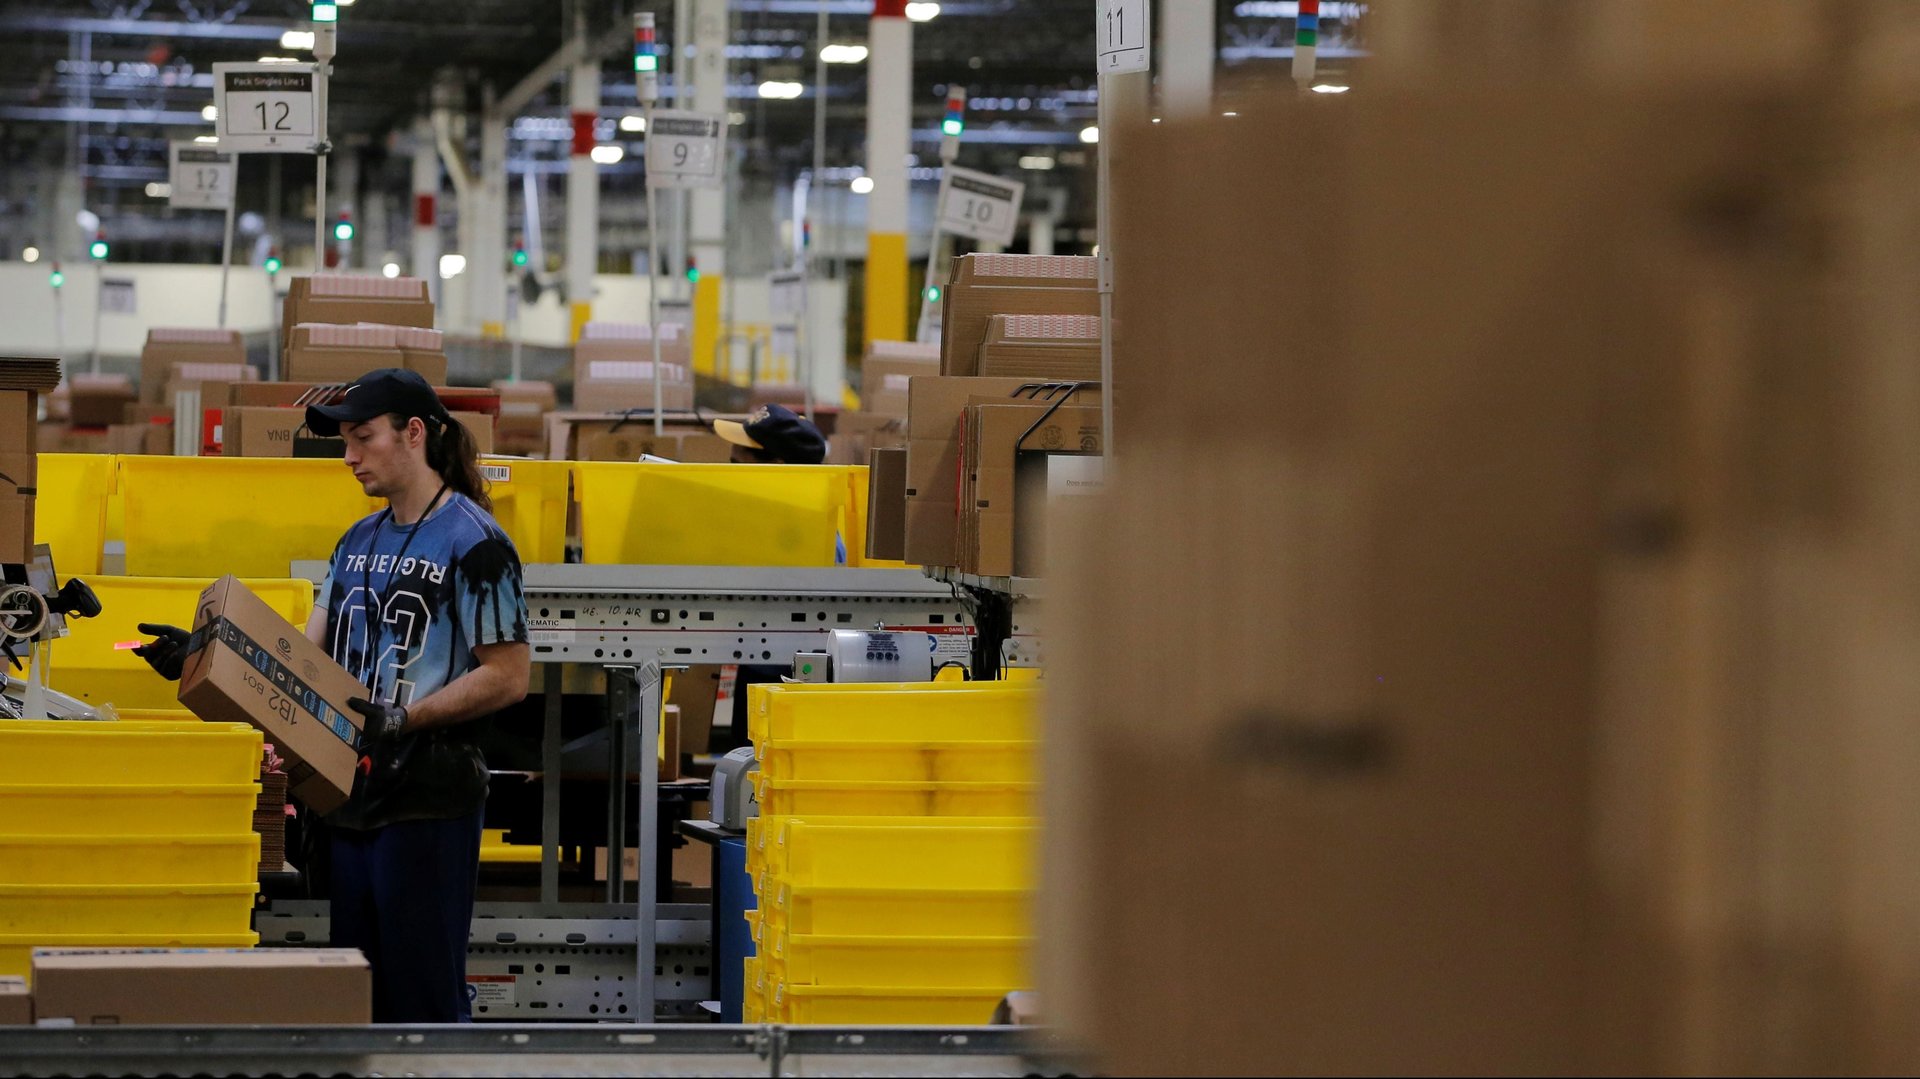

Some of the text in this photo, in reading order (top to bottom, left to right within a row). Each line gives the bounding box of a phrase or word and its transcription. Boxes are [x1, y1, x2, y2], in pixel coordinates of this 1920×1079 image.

[1107, 6, 1123, 47] 11
[233, 77, 252, 86] Pack
[284, 77, 299, 86] Line
[255, 101, 291, 130] 12
[674, 142, 688, 167] 9
[196, 168, 219, 190] 12
[962, 199, 993, 224] 10
[267, 428, 291, 441] BNA
[625, 607, 642, 617] AIR
[267, 688, 298, 726] 1B2
